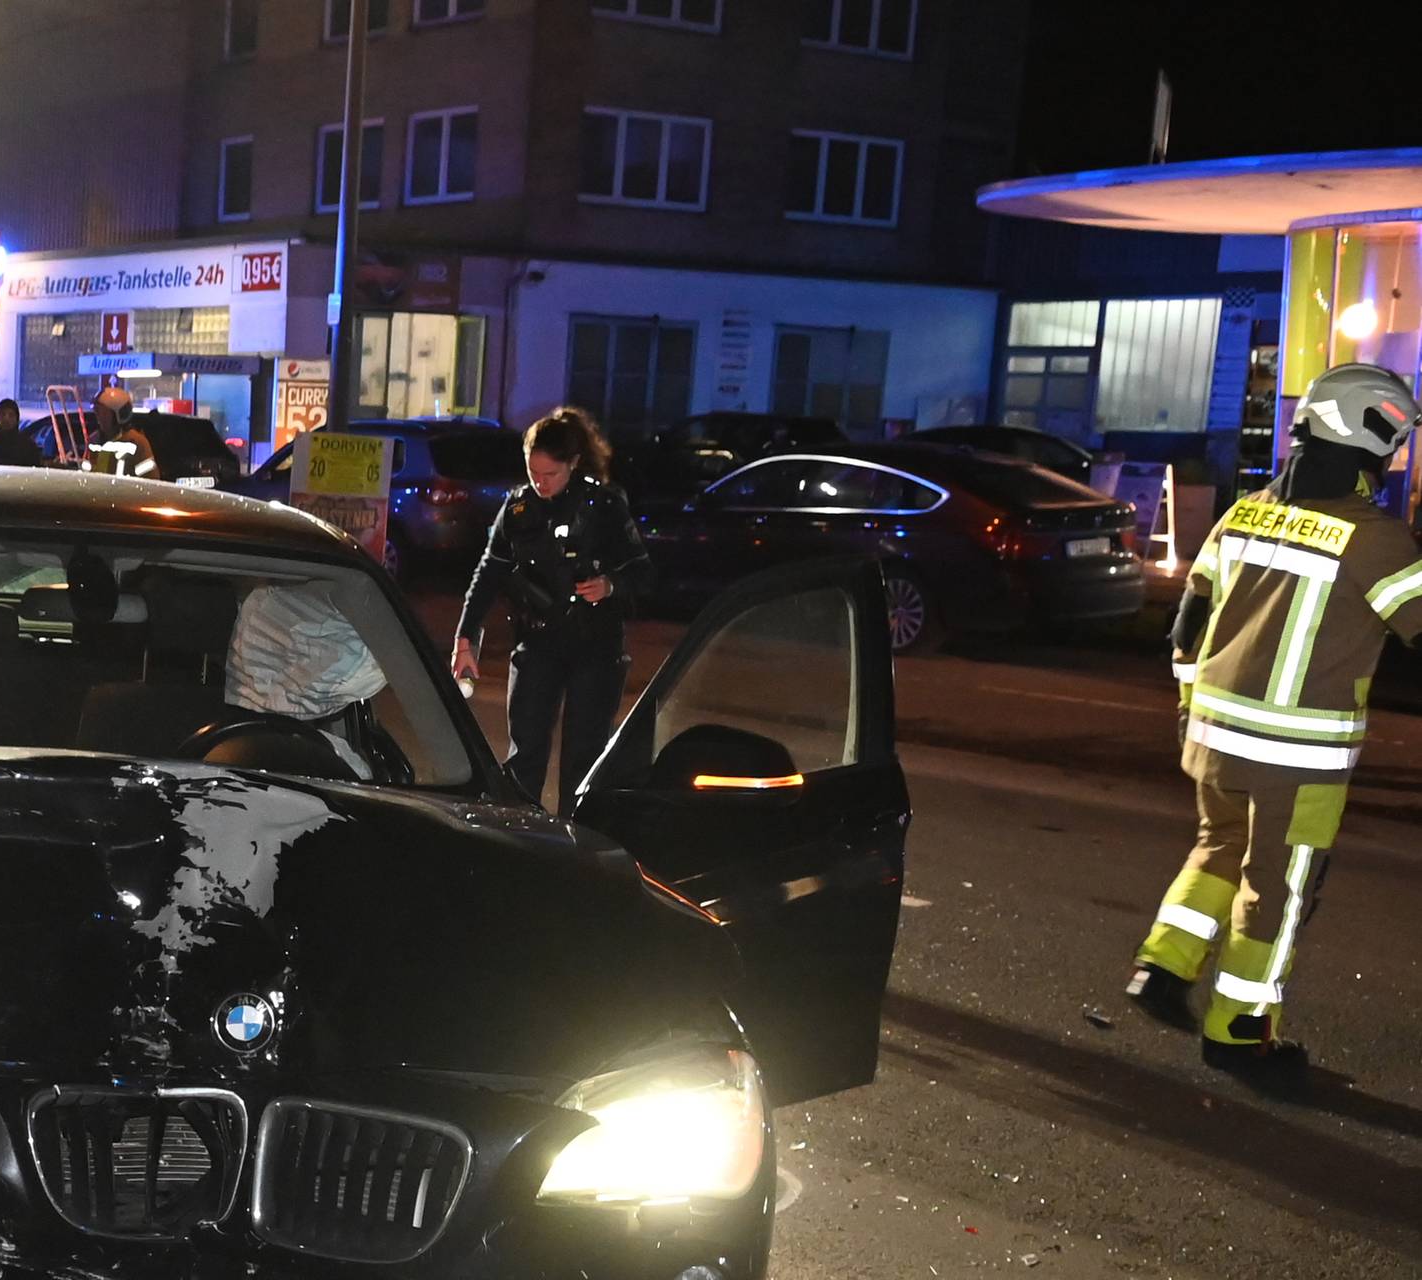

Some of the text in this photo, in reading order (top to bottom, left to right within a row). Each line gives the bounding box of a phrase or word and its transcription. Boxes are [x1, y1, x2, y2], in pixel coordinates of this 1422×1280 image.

[195, 263, 225, 286] 24h
[243, 255, 281, 289] 0,95€
[90, 357, 140, 370] Autogas
[173, 356, 244, 371] Autogas
[288, 387, 329, 405] CURRY
[287, 406, 328, 432] 52
[321, 438, 377, 454] DORSTEN
[309, 456, 326, 478] 20
[1230, 505, 1344, 545] FEUERWEHR
